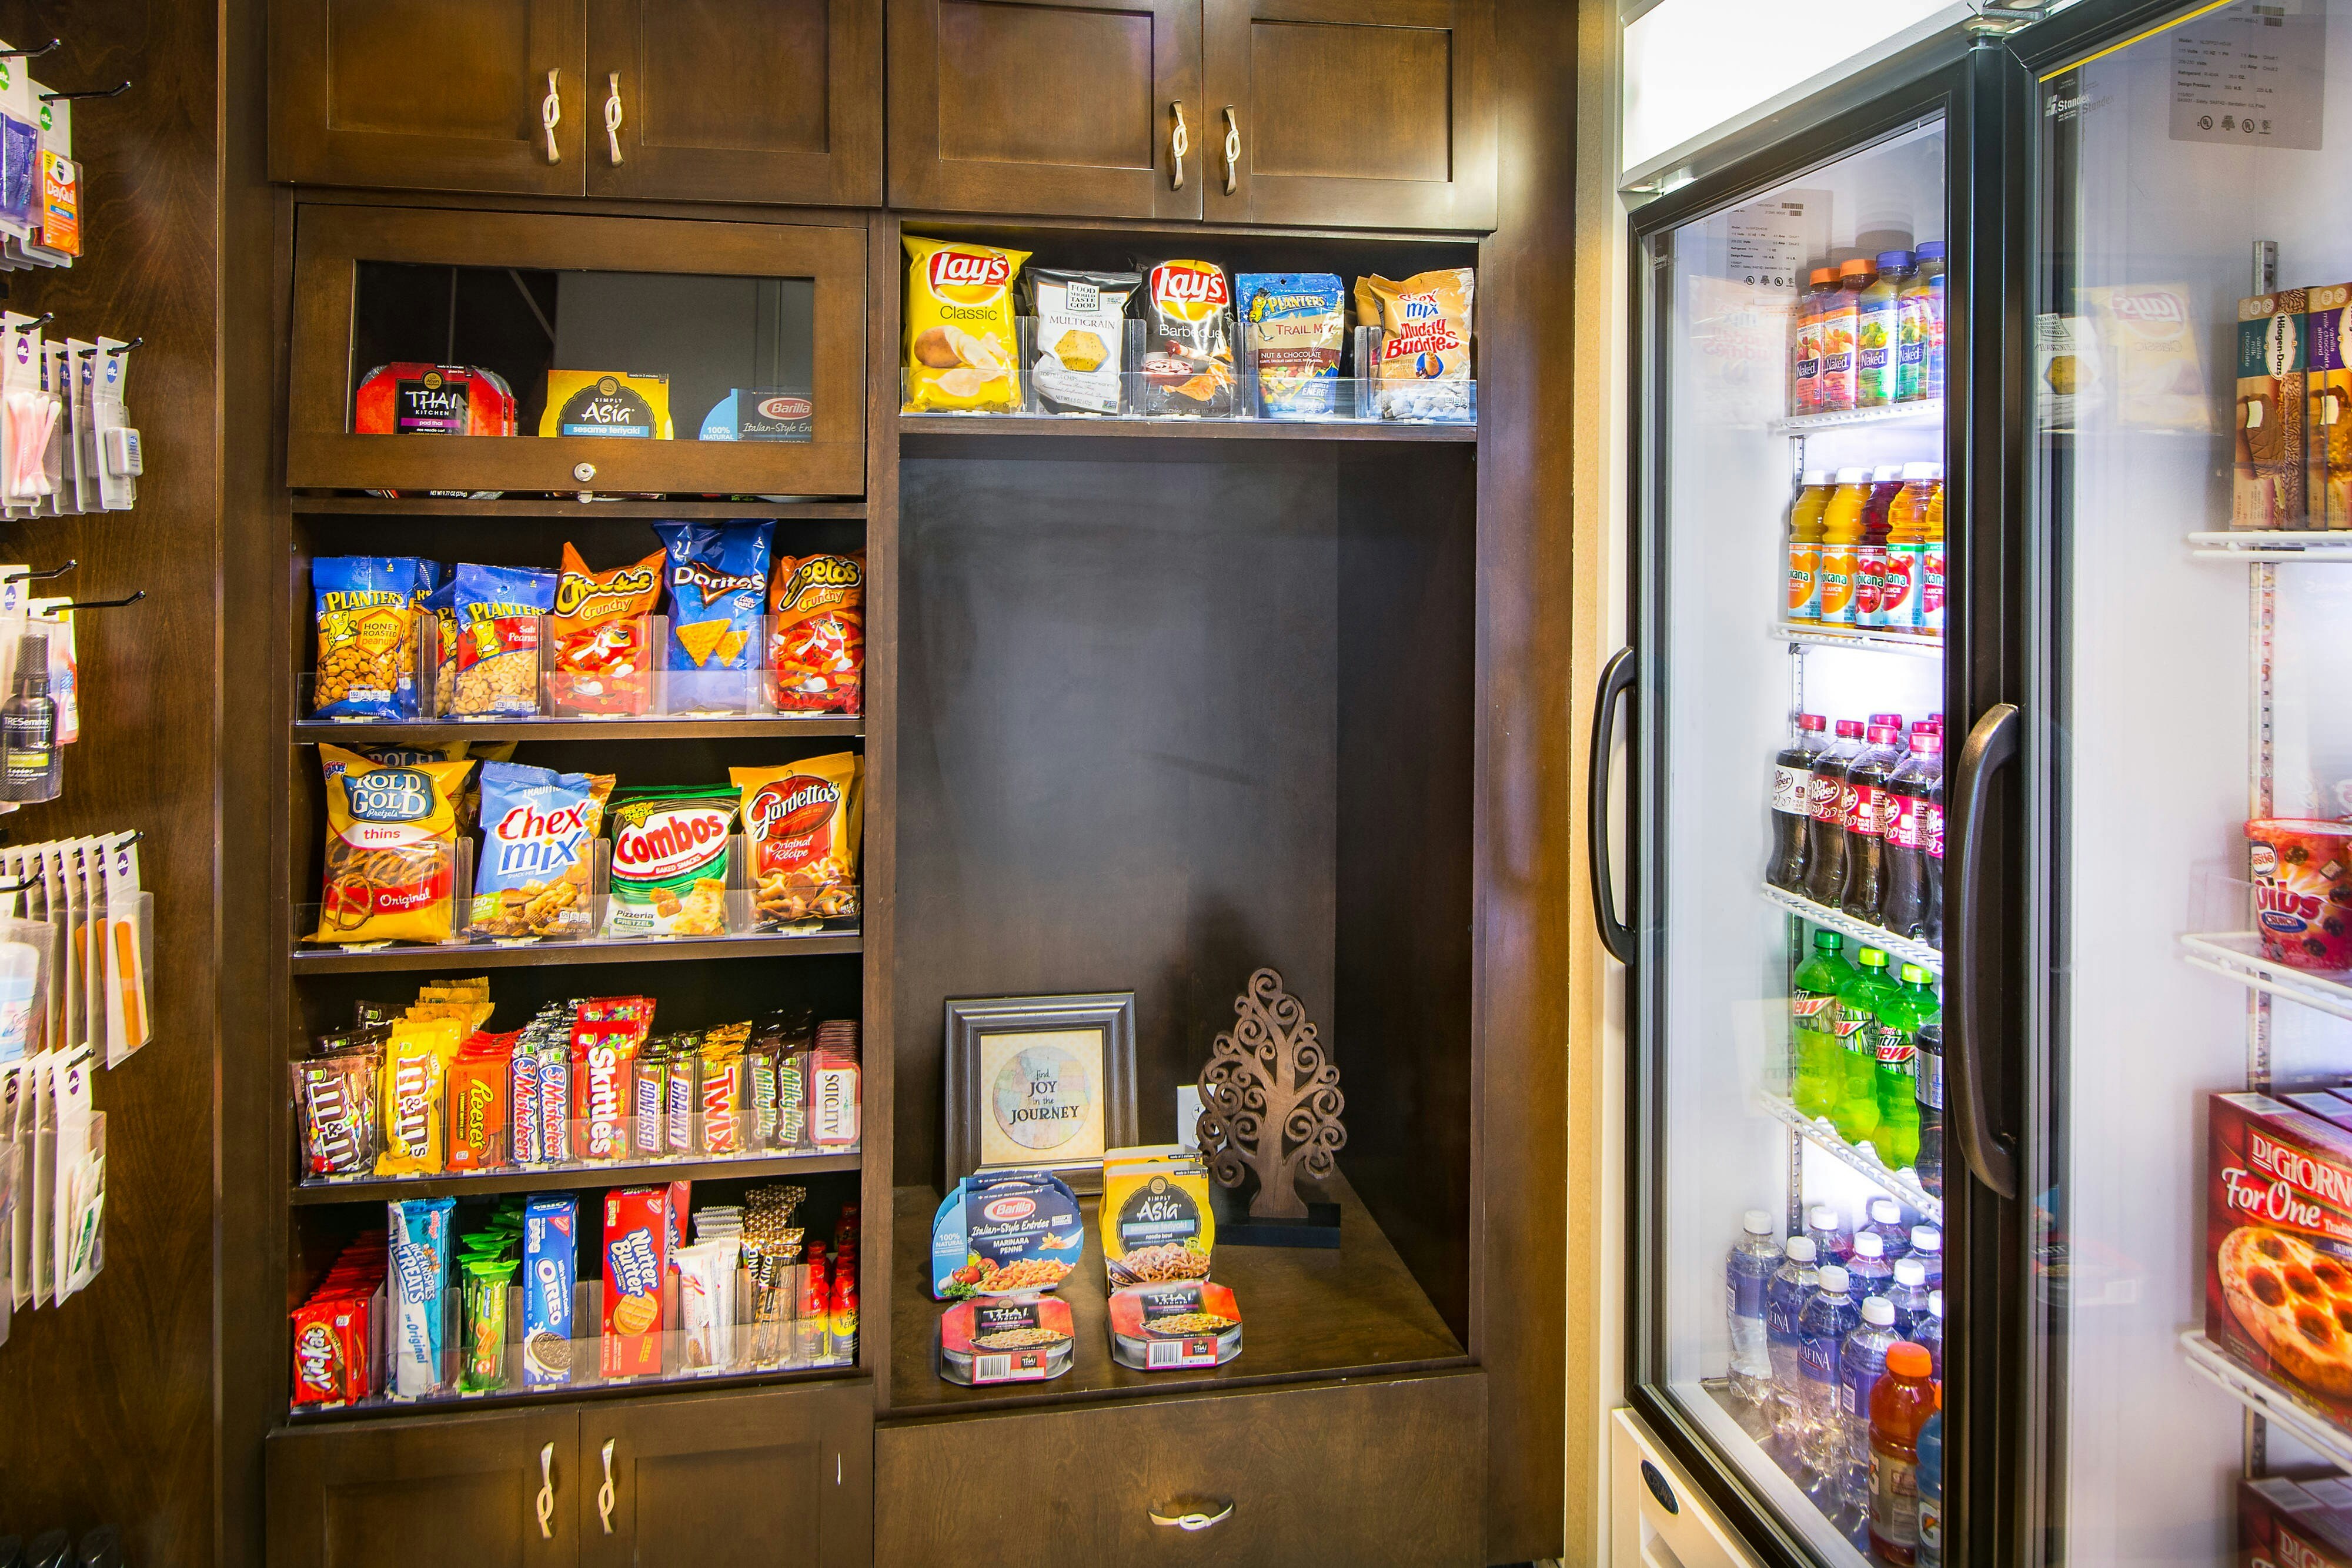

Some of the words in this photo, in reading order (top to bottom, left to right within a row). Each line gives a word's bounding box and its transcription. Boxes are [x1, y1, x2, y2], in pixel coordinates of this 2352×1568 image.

[2057, 94, 2090, 112] Standex
[47, 179, 75, 205] DayQuil
[934, 253, 1006, 286] Lay's
[1071, 285, 1096, 293] FOOD
[1157, 266, 1225, 303] Lay's
[940, 305, 998, 321] Classic
[1267, 295, 1325, 312] PLANTERS
[1406, 303, 1439, 319] mix
[1050, 315, 1115, 329] MULTIGRAIN
[1275, 325, 1311, 336] TRAIL
[1401, 319, 1447, 340] Muddy
[17, 345, 29, 356] etc.
[1384, 330, 1461, 360] Buddies
[2274, 315, 2286, 376] Häagen-Dazs
[1826, 355, 1849, 371] Naked
[1861, 353, 1886, 368] Naked
[1900, 349, 1920, 364] Naked
[107, 366, 118, 377] etc.
[1796, 363, 1817, 378] Naked
[405, 390, 457, 410] THAI
[1302, 387, 1328, 396] ENERGY
[581, 402, 632, 424] Asia
[771, 402, 810, 413] Barilla
[609, 426, 640, 435] teriyaki
[743, 422, 797, 435] Italian-Style
[673, 566, 766, 590] Doritos
[326, 591, 403, 611] PLANTERS
[580, 597, 632, 620] Crunchy
[739, 596, 754, 604] COOL
[797, 590, 844, 612] Crunchy
[468, 601, 547, 623] PLANTERS
[364, 623, 399, 631] HONEY
[361, 637, 396, 647] peanuts
[4, 714, 50, 727] TRESemmé
[356, 774, 422, 793] ROLD
[1775, 777, 1791, 791] pper
[1811, 780, 1836, 801] Pepper
[1816, 779, 1828, 788] Dr
[352, 790, 427, 815] GOLD
[624, 806, 649, 815] REAL
[745, 782, 841, 842] Gardetto's
[366, 809, 398, 819] Pretzels
[497, 801, 587, 840] Chex
[624, 808, 655, 822] CHEESE
[363, 828, 401, 840] thins
[616, 814, 724, 864] Combos
[769, 834, 813, 853] Original
[501, 831, 583, 871] mix
[774, 848, 809, 861] Recipe
[655, 865, 676, 874] BAKED
[677, 854, 702, 869] SNACKS
[379, 891, 431, 908] Original
[473, 896, 495, 908] 60%
[616, 910, 654, 919] Pizzeria
[617, 918, 651, 927] PRETZEL
[2266, 914, 2299, 927] CRUNCH
[1879, 1026, 1896, 1035] diet
[517, 1059, 536, 1077] 3
[546, 1069, 564, 1083] 3
[1035, 1068, 1050, 1081] find
[753, 1067, 776, 1109] Milky
[779, 1067, 803, 1111] Milky
[1028, 1081, 1058, 1098] JOY
[588, 1046, 618, 1154] Skittles
[618, 1088, 626, 1116] Original
[824, 1074, 840, 1134] ALTOIDS
[1033, 1097, 1040, 1105] in
[1043, 1096, 1054, 1105] the
[470, 1078, 495, 1151] Reese's
[513, 1075, 537, 1162] Musketeers
[639, 1081, 656, 1148] CONFUSED
[671, 1081, 688, 1147] CRANKY
[703, 1067, 736, 1154] TWIX
[1009, 1105, 1080, 1126] JOURNEY
[754, 1108, 777, 1139] Way
[779, 1109, 804, 1142] Way
[2221, 1166, 2267, 1209] For
[2266, 1181, 2321, 1229] One
[995, 1201, 1031, 1215] Barilla
[1137, 1200, 1178, 1221] Asia
[428, 1209, 441, 1239] Kellogg's
[971, 1222, 1020, 1237] Italian-Style
[1021, 1218, 1050, 1231] Entrées
[1131, 1224, 1160, 1232] sesame
[1161, 1221, 1187, 1232] teriyaki
[936, 1239, 964, 1248] NATURAL
[939, 1232, 960, 1241] 100%
[993, 1236, 1030, 1248] MARINARA
[627, 1228, 659, 1289] Nutter
[1000, 1245, 1023, 1253] PENNE
[396, 1243, 426, 1305] TREATS
[408, 1242, 423, 1263] RICE
[417, 1258, 437, 1301] KRISPIES
[610, 1238, 644, 1298] Butter
[748, 1248, 759, 1282] KIND
[759, 1254, 773, 1287] KIND
[534, 1258, 563, 1327] OREO
[559, 1277, 567, 1296] Favorite
[1148, 1293, 1194, 1303] THAI
[983, 1307, 1029, 1319] THAI
[407, 1323, 428, 1364] Original
